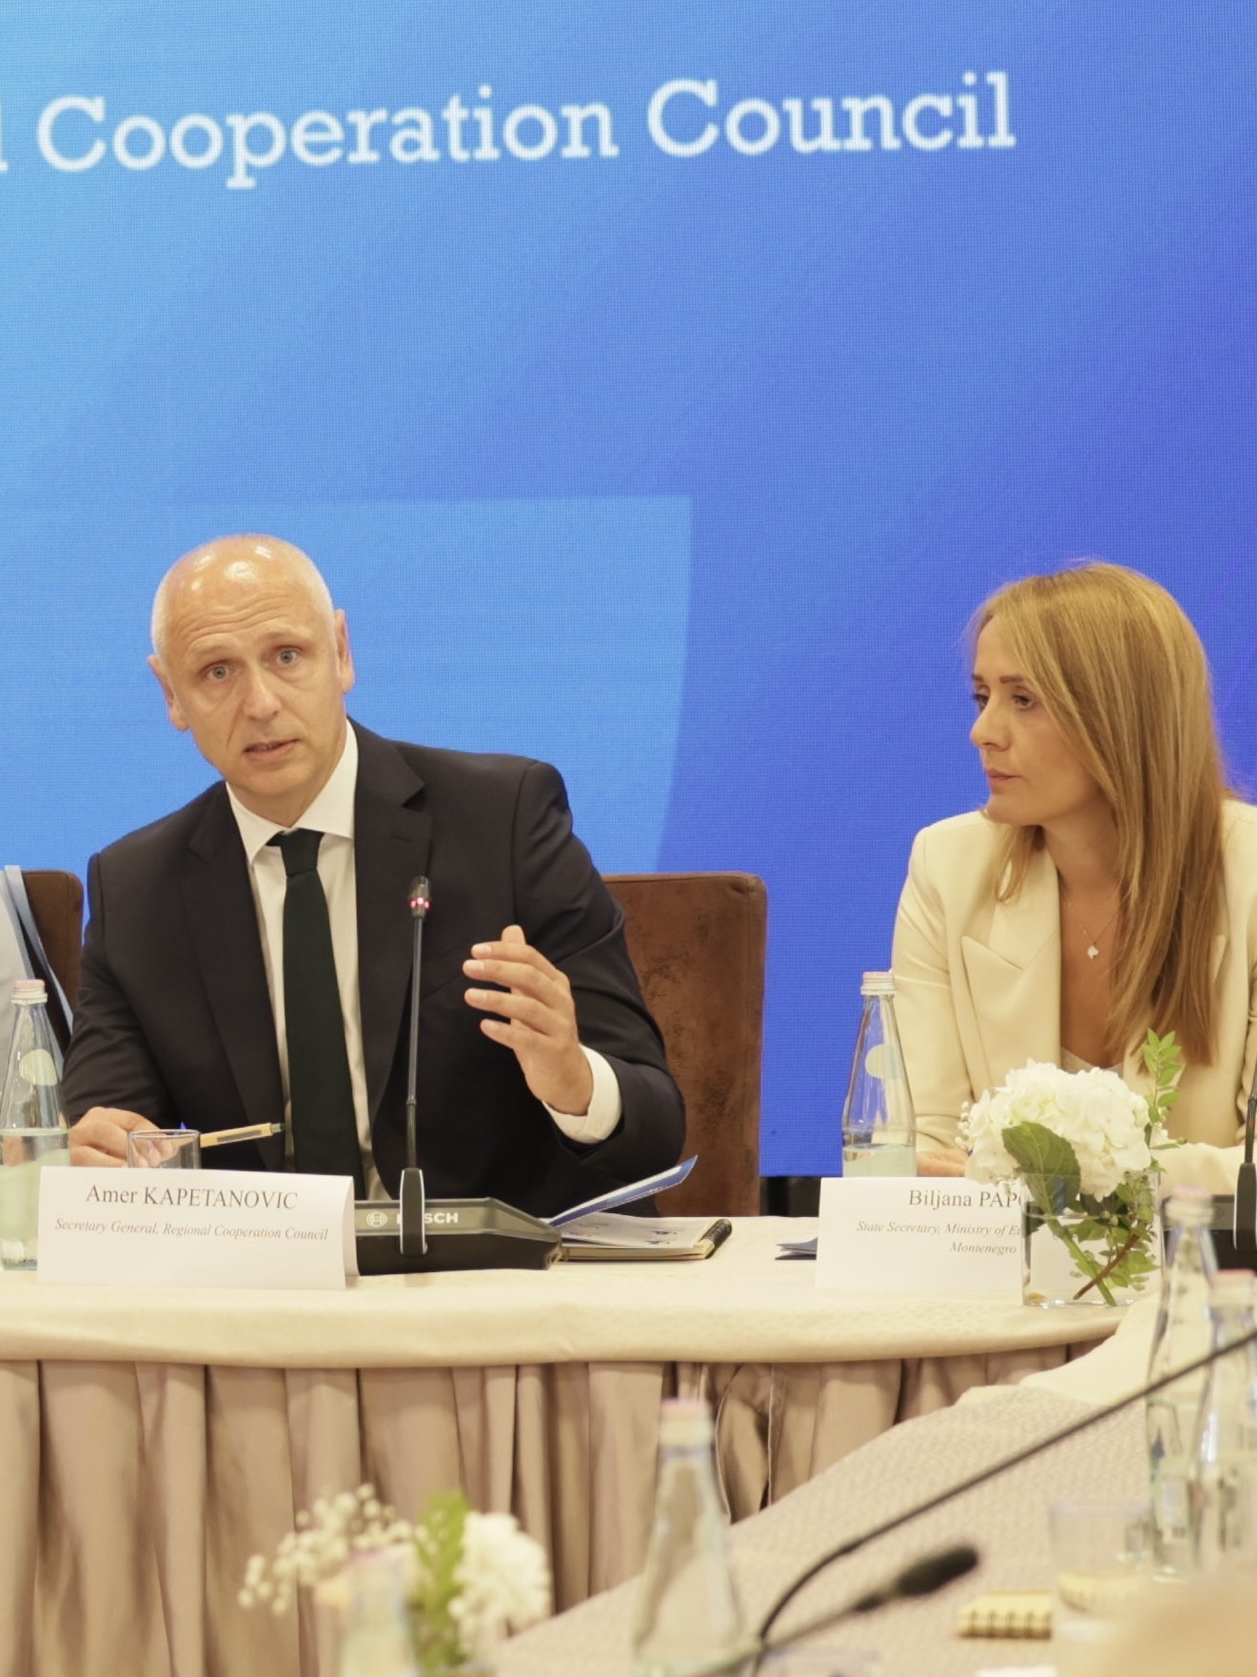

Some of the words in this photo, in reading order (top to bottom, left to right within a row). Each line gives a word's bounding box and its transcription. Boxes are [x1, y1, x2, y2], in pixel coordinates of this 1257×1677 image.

[37, 95, 619, 189] Cooperation
[648, 72, 1017, 157] Council
[86, 1184, 139, 1205] Amer
[143, 1186, 298, 1210] KAPETANOVIC
[909, 1189, 972, 1210] Biljana
[54, 1217, 108, 1235] Secretary
[163, 1222, 212, 1238] Regional
[214, 1224, 282, 1240] Cooperation
[285, 1226, 329, 1241] Council
[856, 1220, 884, 1233] State
[944, 1223, 992, 1237] Ministry
[994, 1224, 1008, 1238] of
[949, 1241, 1017, 1256] Montenegro
